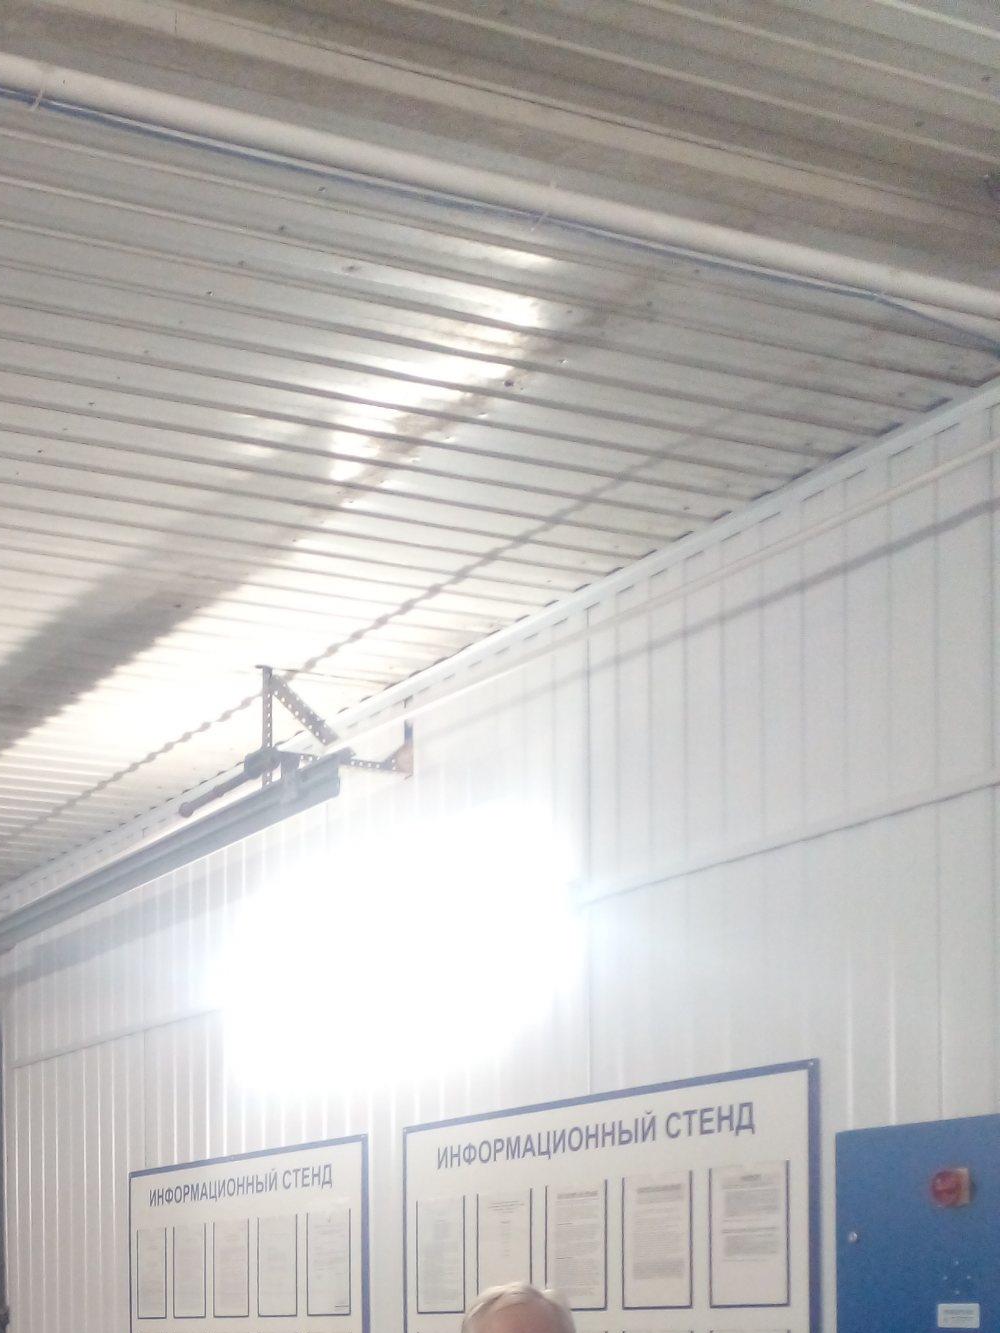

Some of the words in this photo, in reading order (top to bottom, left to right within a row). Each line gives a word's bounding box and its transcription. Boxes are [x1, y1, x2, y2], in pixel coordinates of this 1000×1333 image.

[436, 1110, 656, 1170] ИНФОРМАЦИОННЫЙ
[665, 1101, 756, 1139] СТЕНД
[149, 1168, 278, 1207] ИНФОРМАЦИОННЫЙ
[282, 1164, 333, 1189] СТЕНД
